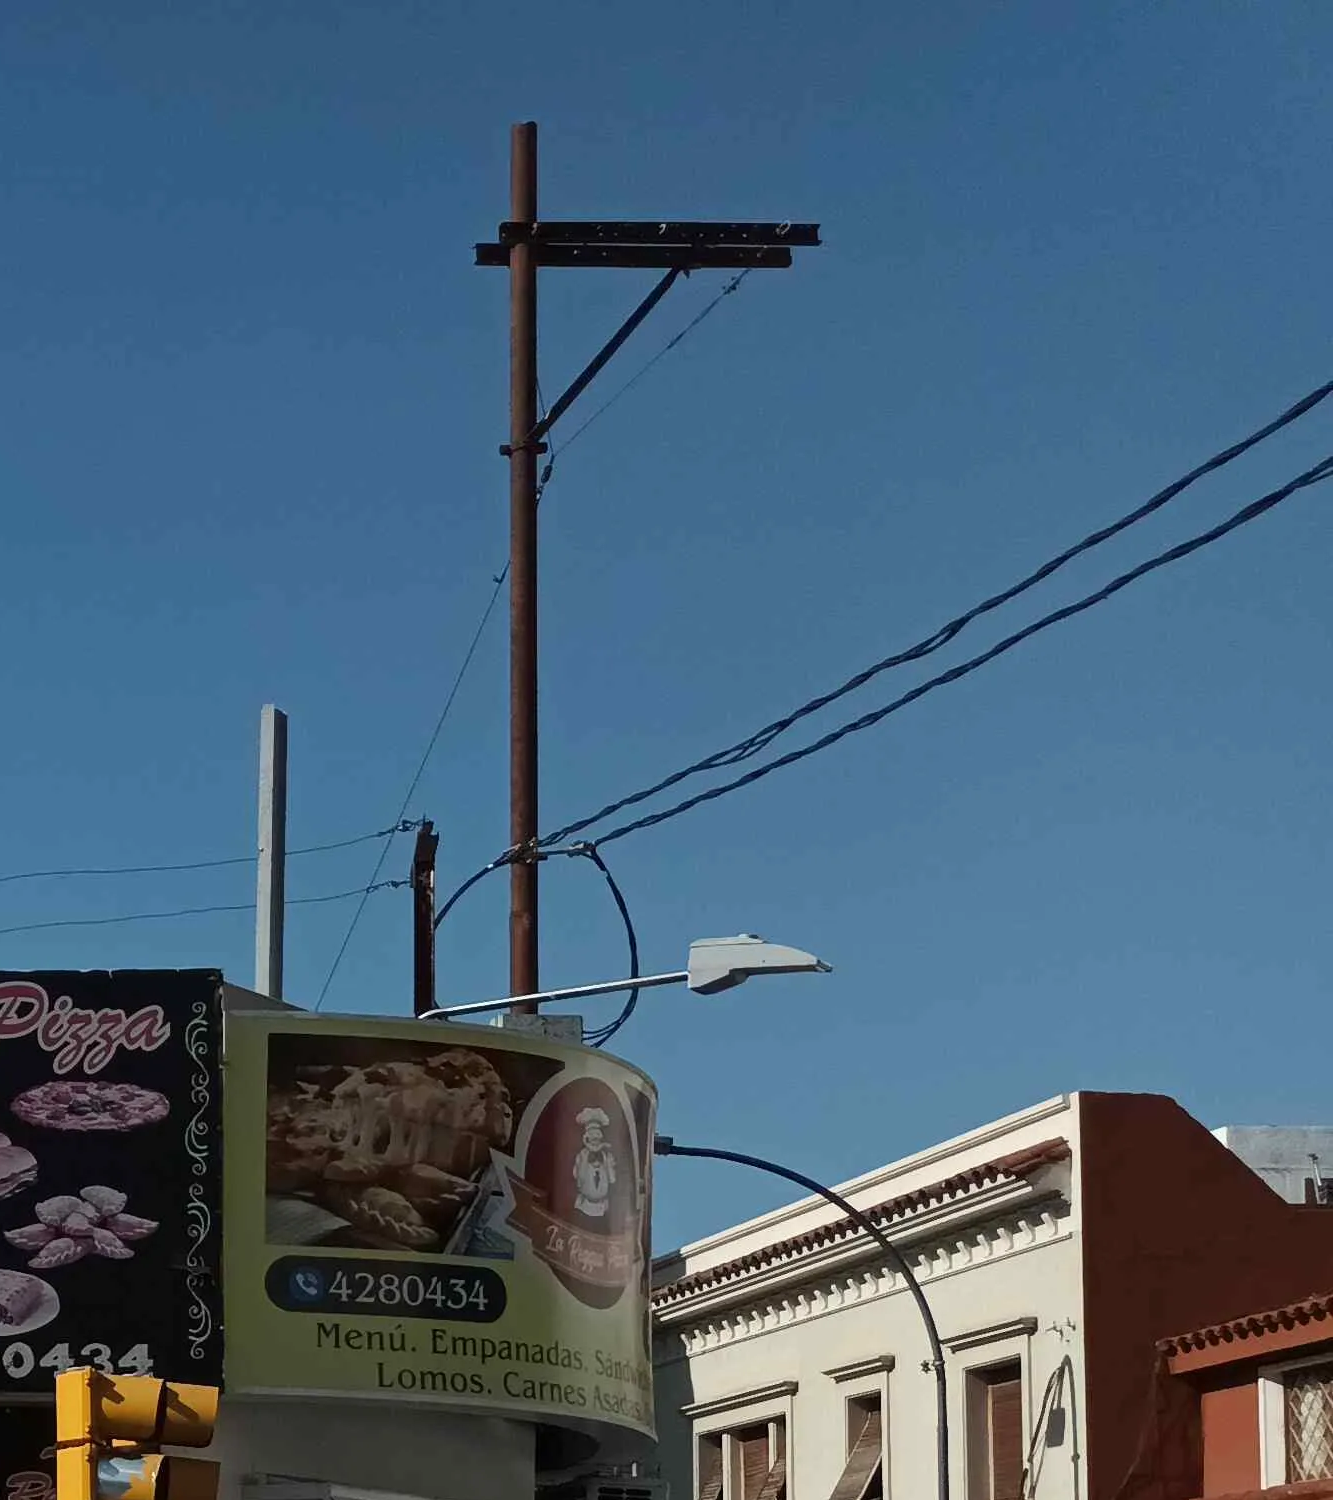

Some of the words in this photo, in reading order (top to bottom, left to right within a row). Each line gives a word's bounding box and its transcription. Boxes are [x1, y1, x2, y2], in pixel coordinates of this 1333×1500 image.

[328, 1269, 489, 1311] 4280434
[316, 1322, 417, 1352] Menú.
[431, 1328, 588, 1371] Empanadas.
[377, 1362, 492, 1395] Lomos.
[503, 1371, 587, 1407] Carnes
